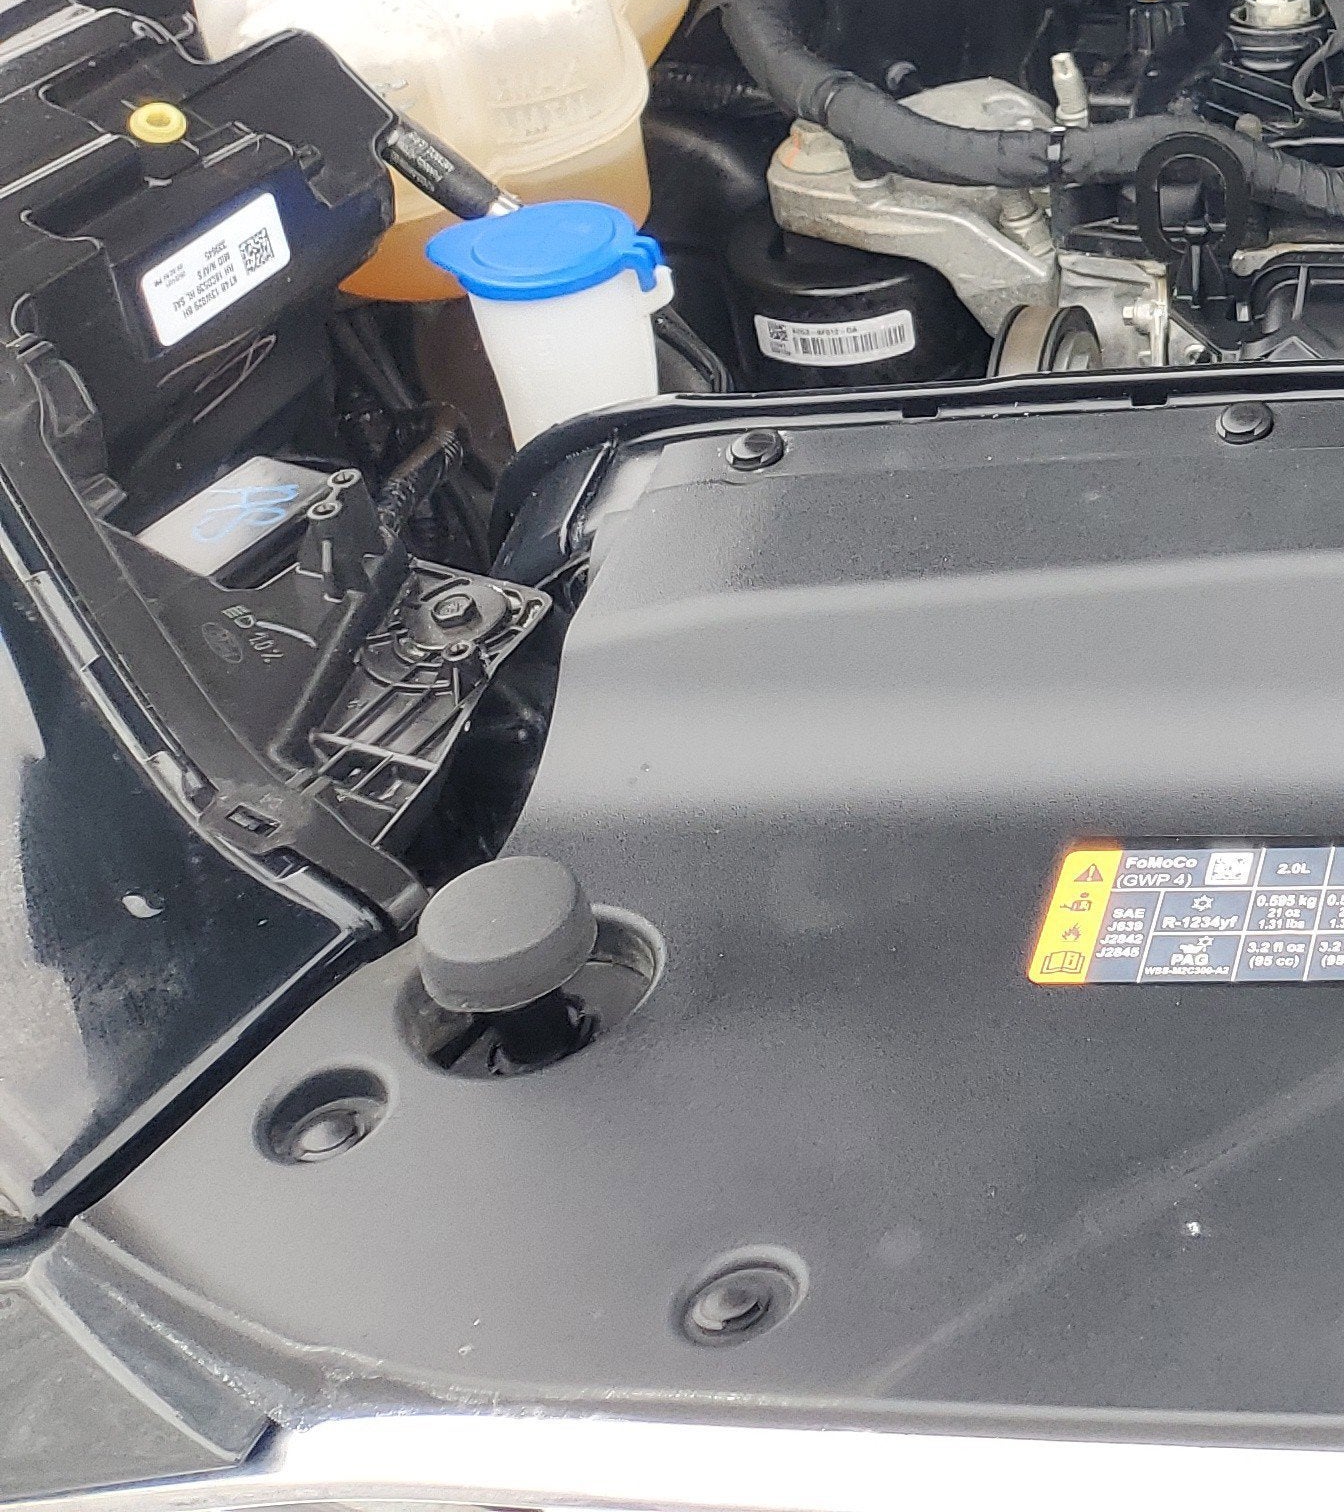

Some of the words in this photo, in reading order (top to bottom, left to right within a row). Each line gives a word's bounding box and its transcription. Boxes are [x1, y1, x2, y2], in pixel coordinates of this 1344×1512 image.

[1125, 856, 1198, 869] FoMoCo
[1277, 863, 1310, 874] 2.0L
[1117, 874, 1170, 888] (GWP
[1174, 874, 1192, 888] 4)
[1299, 895, 1317, 908] kg
[1113, 908, 1145, 918] SAE
[1267, 908, 1282, 918] 21
[1285, 909, 1300, 918] oz
[1162, 916, 1238, 930] R-1234yf
[1259, 919, 1283, 929] 1.31
[1286, 919, 1305, 928] lbs
[1247, 942, 1270, 953] 3.2
[1273, 942, 1284, 952] fl
[1286, 944, 1305, 952] oz
[1319, 941, 1342, 952] 3.2
[1170, 954, 1209, 966] PAG
[1276, 955, 1299, 968] cc)
